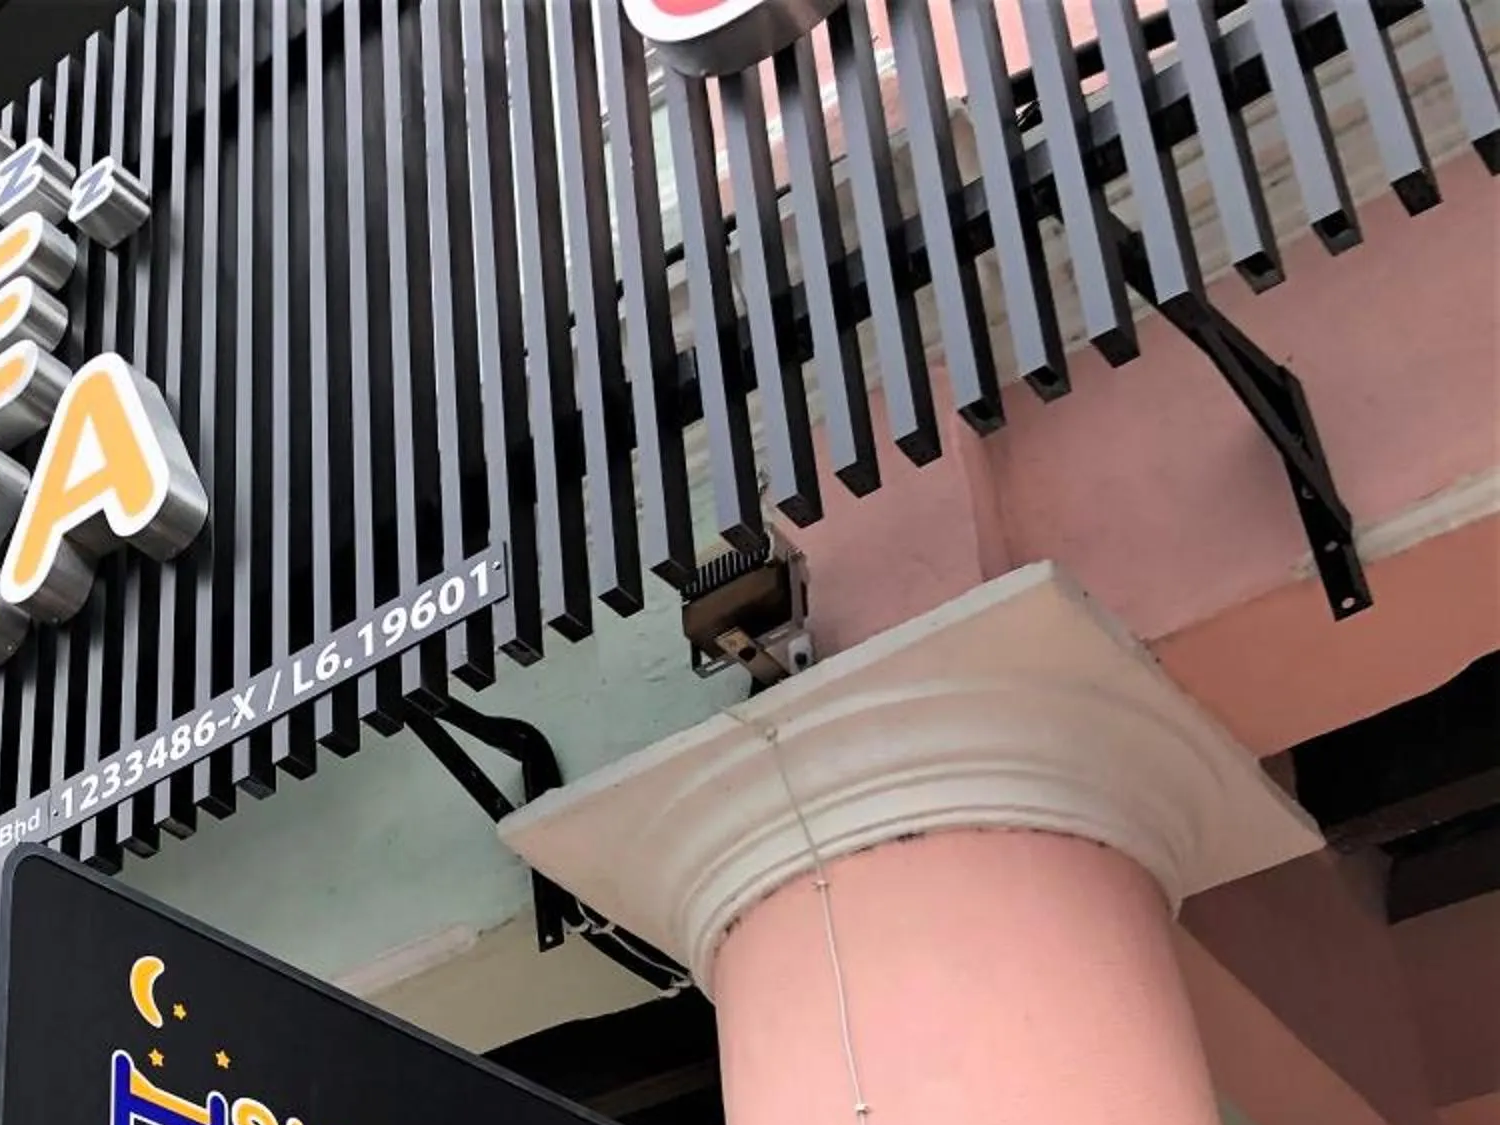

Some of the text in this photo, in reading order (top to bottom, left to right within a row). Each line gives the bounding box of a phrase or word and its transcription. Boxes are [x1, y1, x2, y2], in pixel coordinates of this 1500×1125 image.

[0, 807, 41, 849] Bhd
[61, 686, 255, 820] 1233486-X
[266, 671, 282, 712] /
[293, 560, 491, 697] L6.19601
